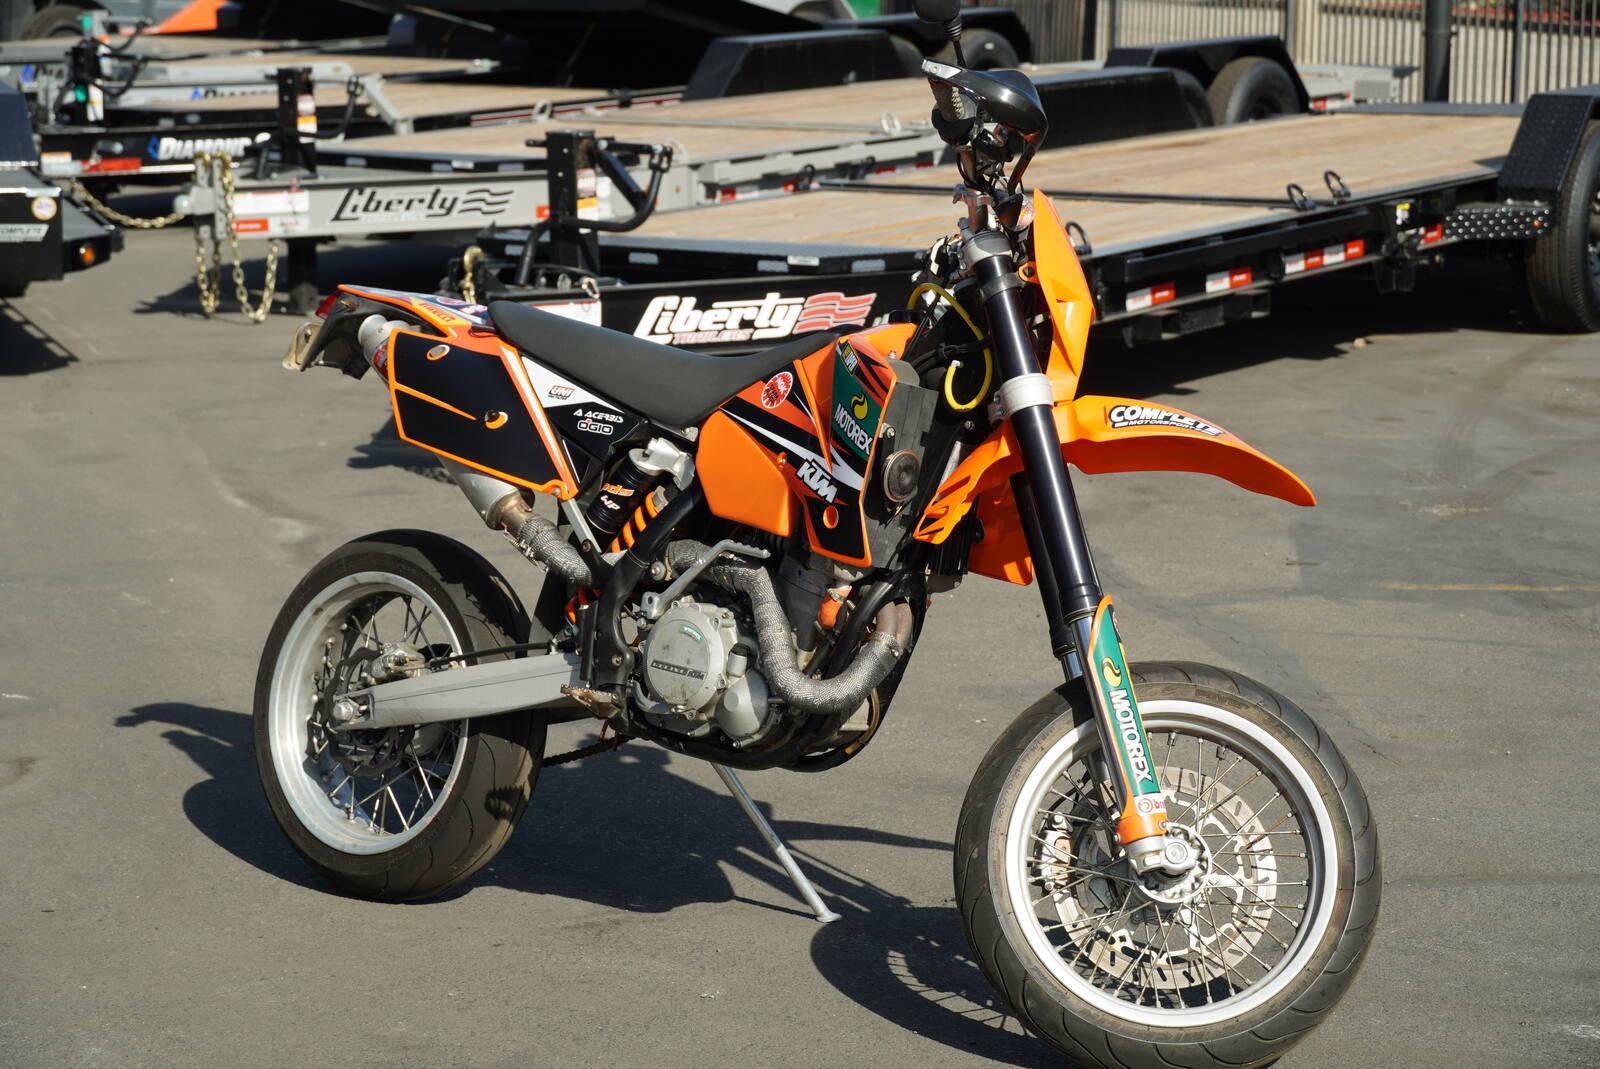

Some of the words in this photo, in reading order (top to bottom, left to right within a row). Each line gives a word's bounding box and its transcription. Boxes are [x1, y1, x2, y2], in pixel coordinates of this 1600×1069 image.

[331, 187, 458, 222] Liberty
[633, 292, 805, 346] Liberty
[549, 385, 575, 398] UNI
[775, 377, 788, 394] NGK
[577, 419, 614, 435] OGIO
[584, 411, 624, 423] ACERBIS
[834, 402, 873, 455] MOTOREX
[1110, 405, 1224, 435] COMPLETE
[796, 461, 838, 503] KTM
[1109, 689, 1153, 784] MOTOREX
